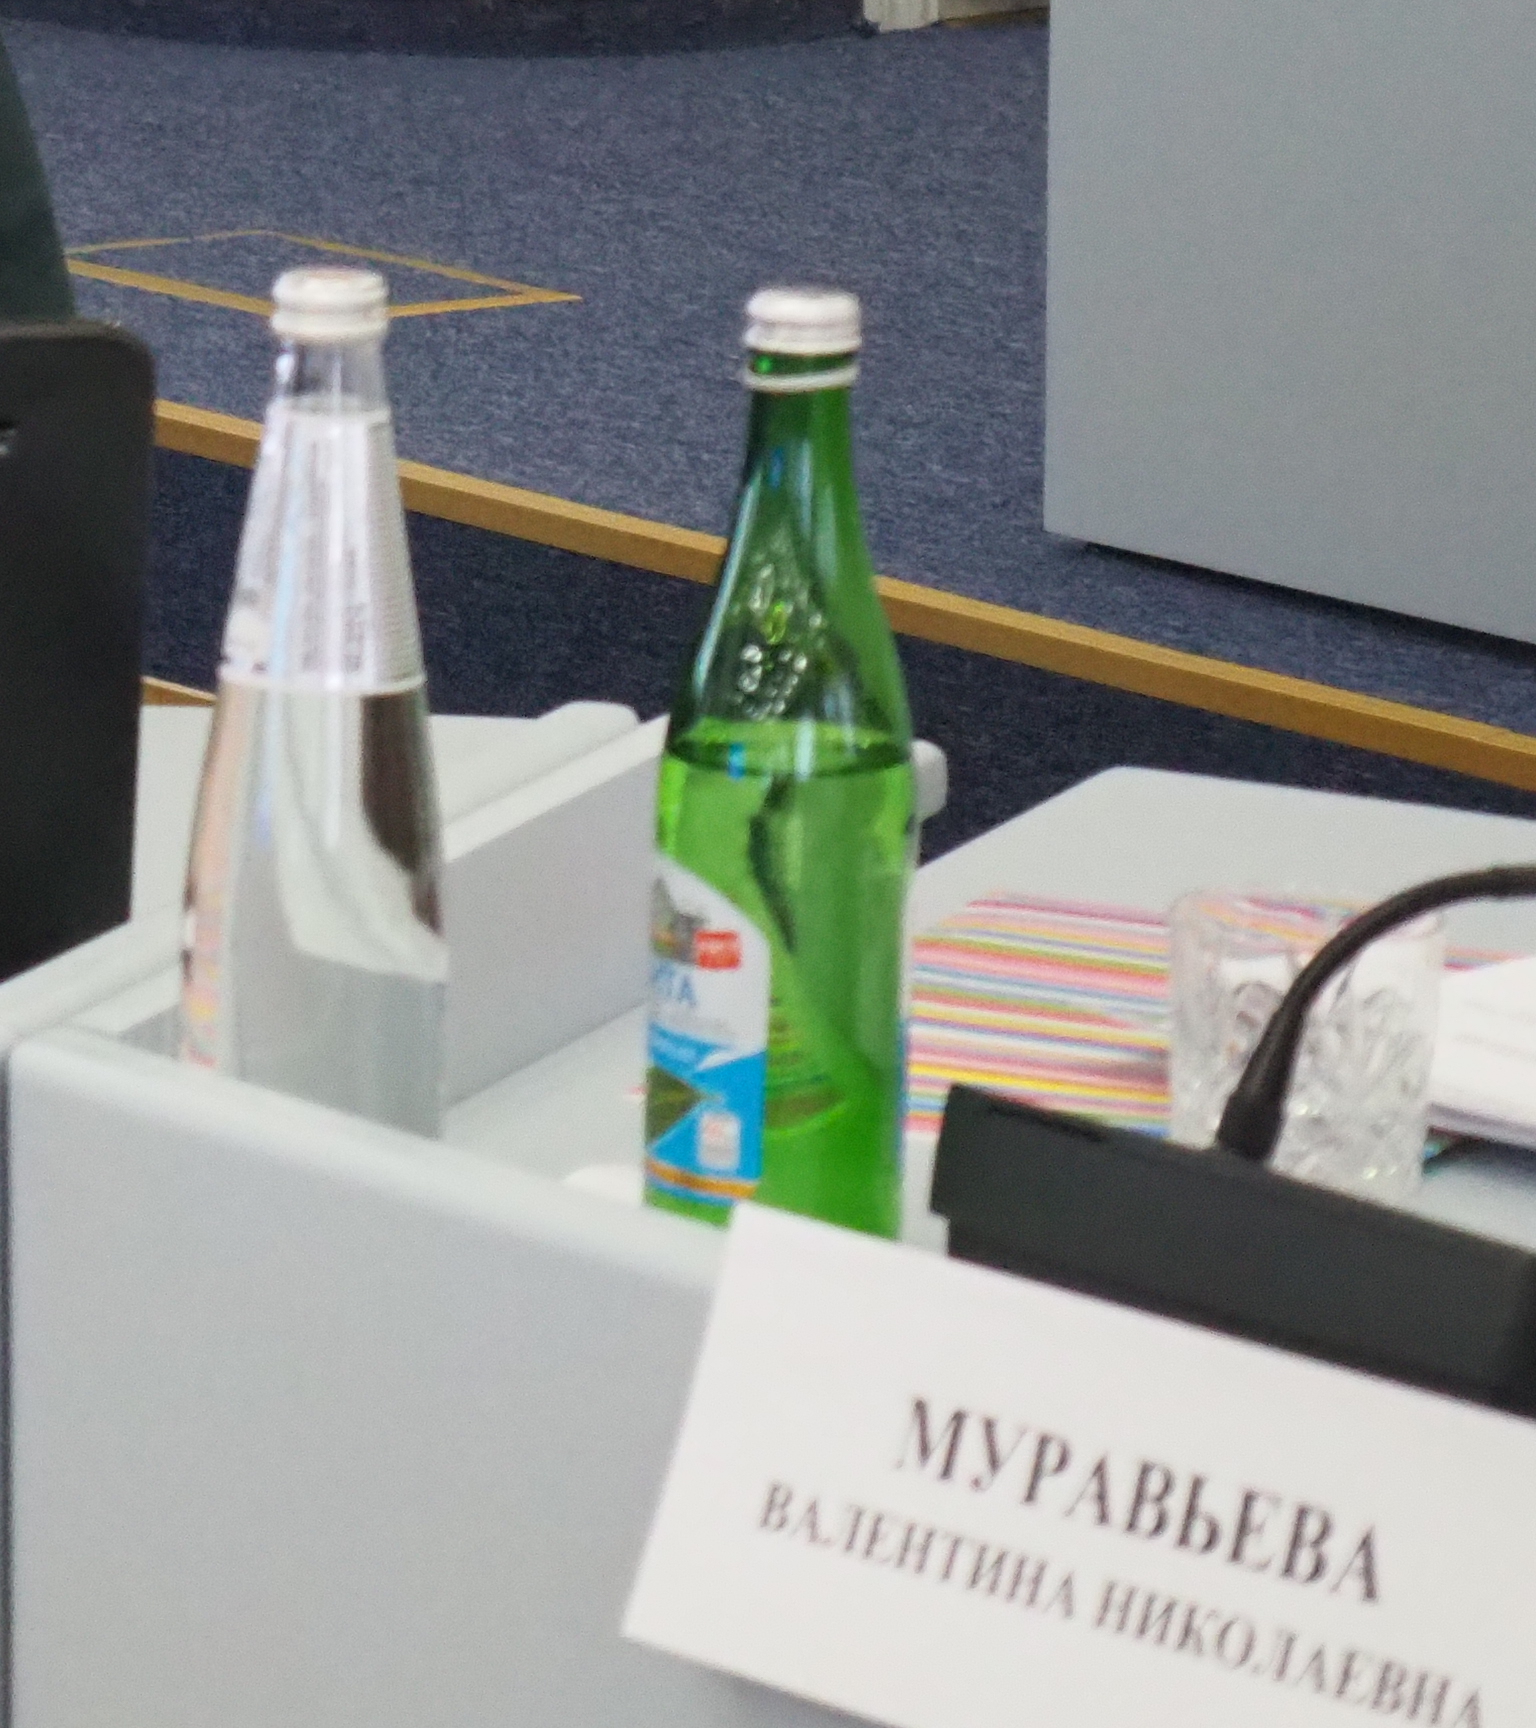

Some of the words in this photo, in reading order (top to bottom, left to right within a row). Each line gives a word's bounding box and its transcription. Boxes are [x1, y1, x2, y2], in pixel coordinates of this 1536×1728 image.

[757, 1481, 1077, 1618] ВАЛЕНТИНА
[1093, 1579, 1484, 1728] НИКОЛАЕВНА
[894, 1396, 1382, 1605] МУРАВЬЕВА
